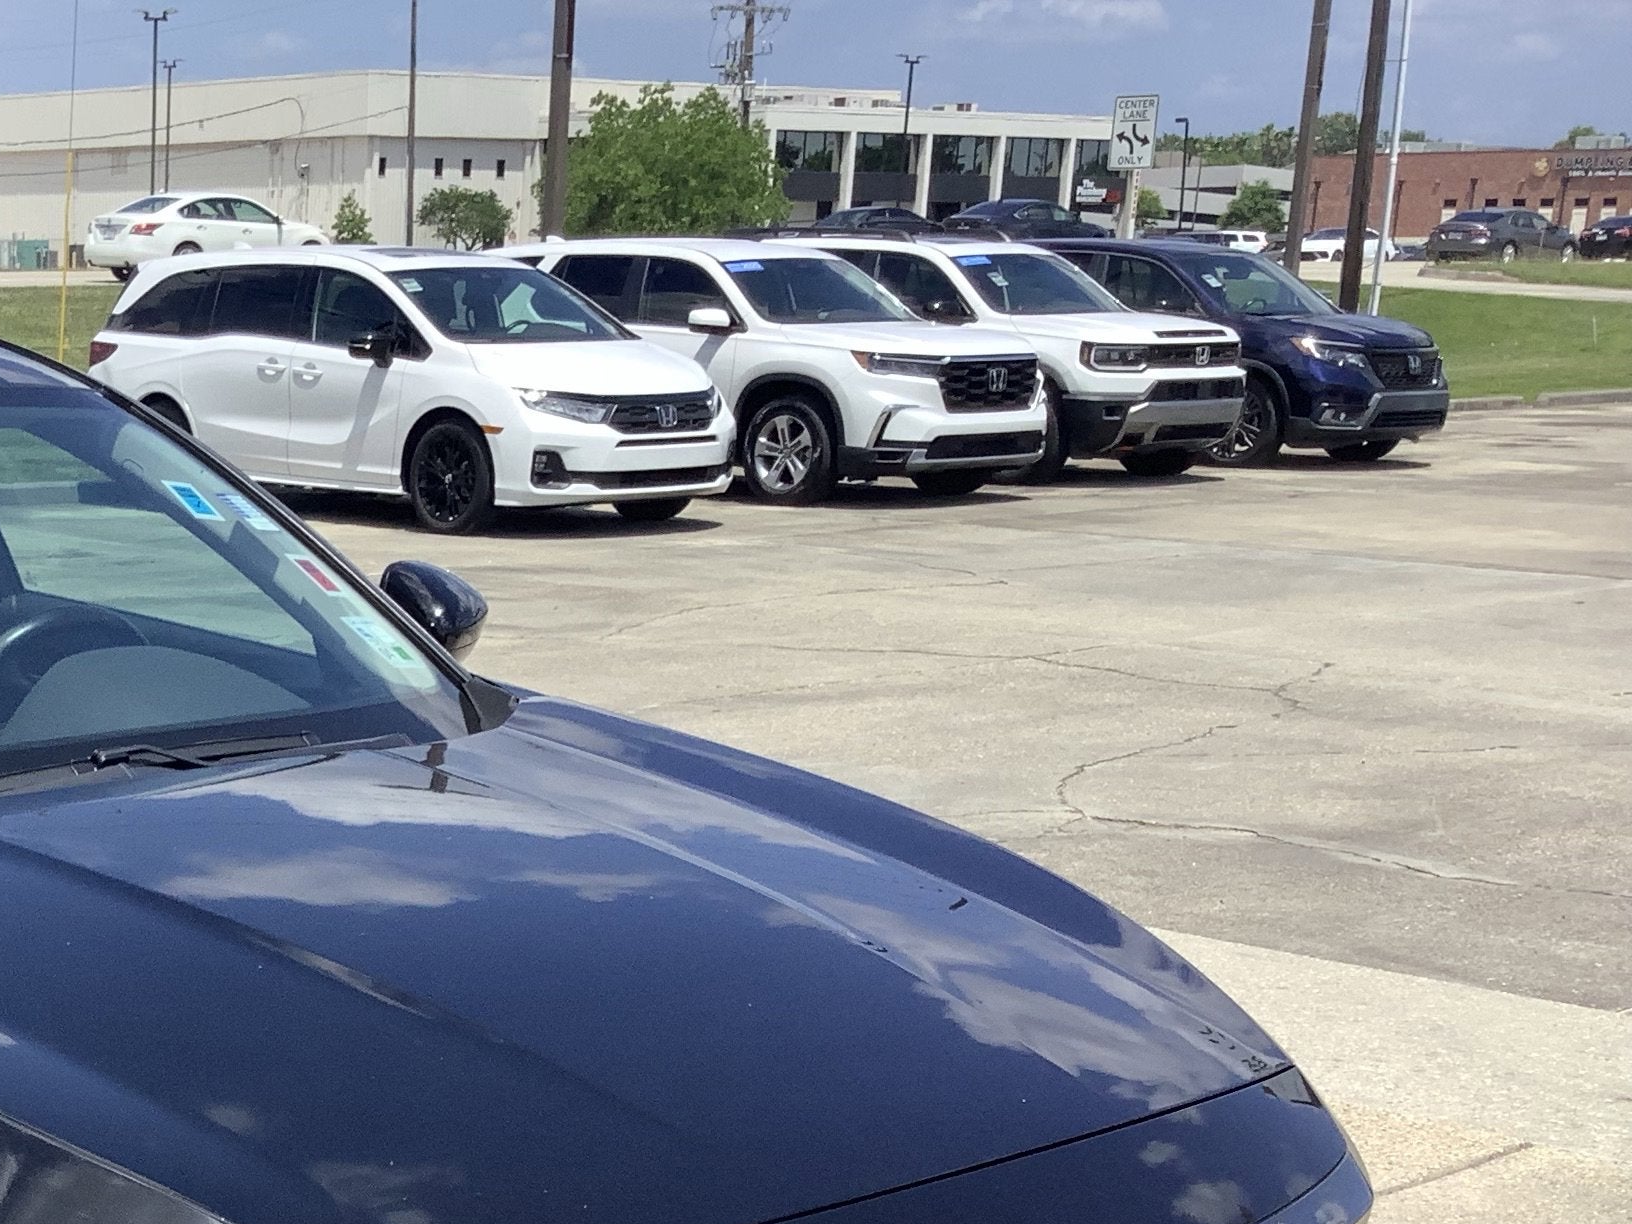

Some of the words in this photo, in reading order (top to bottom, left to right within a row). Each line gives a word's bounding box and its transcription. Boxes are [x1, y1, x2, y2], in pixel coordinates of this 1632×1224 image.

[1118, 99, 1155, 110] CENTER
[1123, 109, 1148, 119] LANE
[1117, 155, 1144, 165] ONLY
